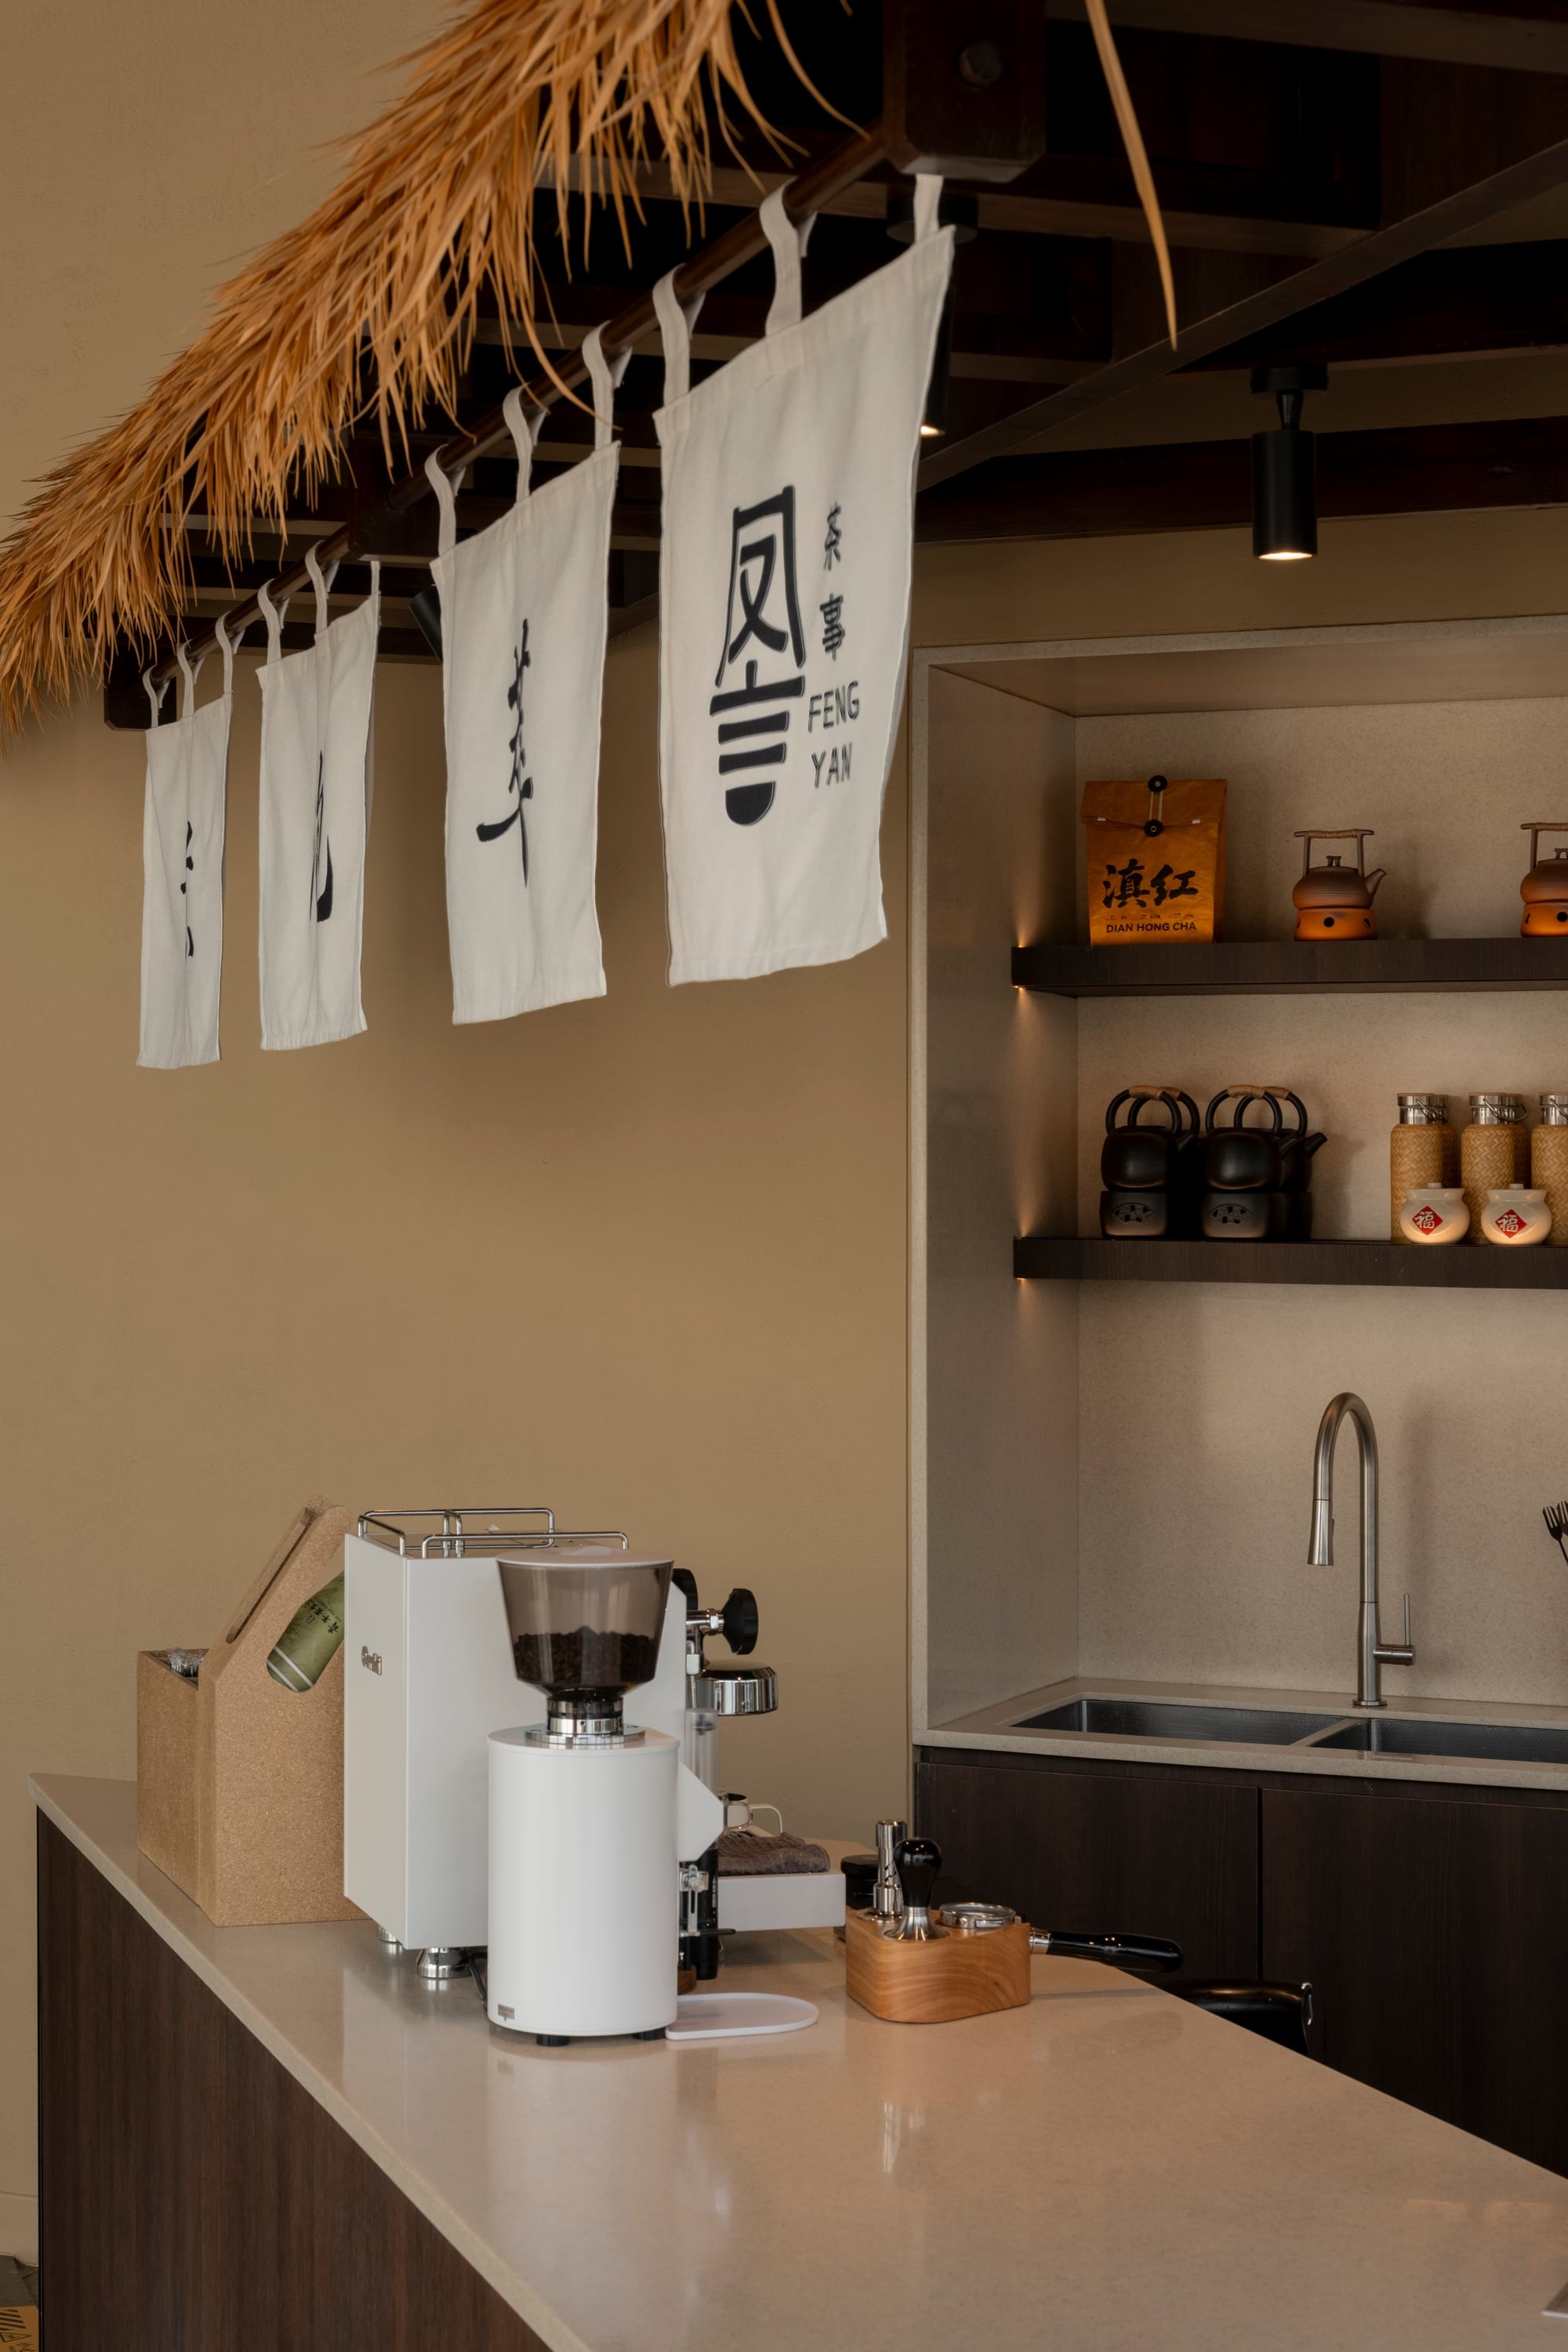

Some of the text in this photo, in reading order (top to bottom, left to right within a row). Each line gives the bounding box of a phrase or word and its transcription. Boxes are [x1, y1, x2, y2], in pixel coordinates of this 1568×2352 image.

[808, 681, 860, 733] FENG
[811, 742, 852, 788] YAN
[1102, 858, 1199, 908] 滇红
[1106, 922, 1196, 933] DIAN HONG CHA
[1415, 1211, 1435, 1229] 福
[1498, 1215, 1518, 1232] 福
